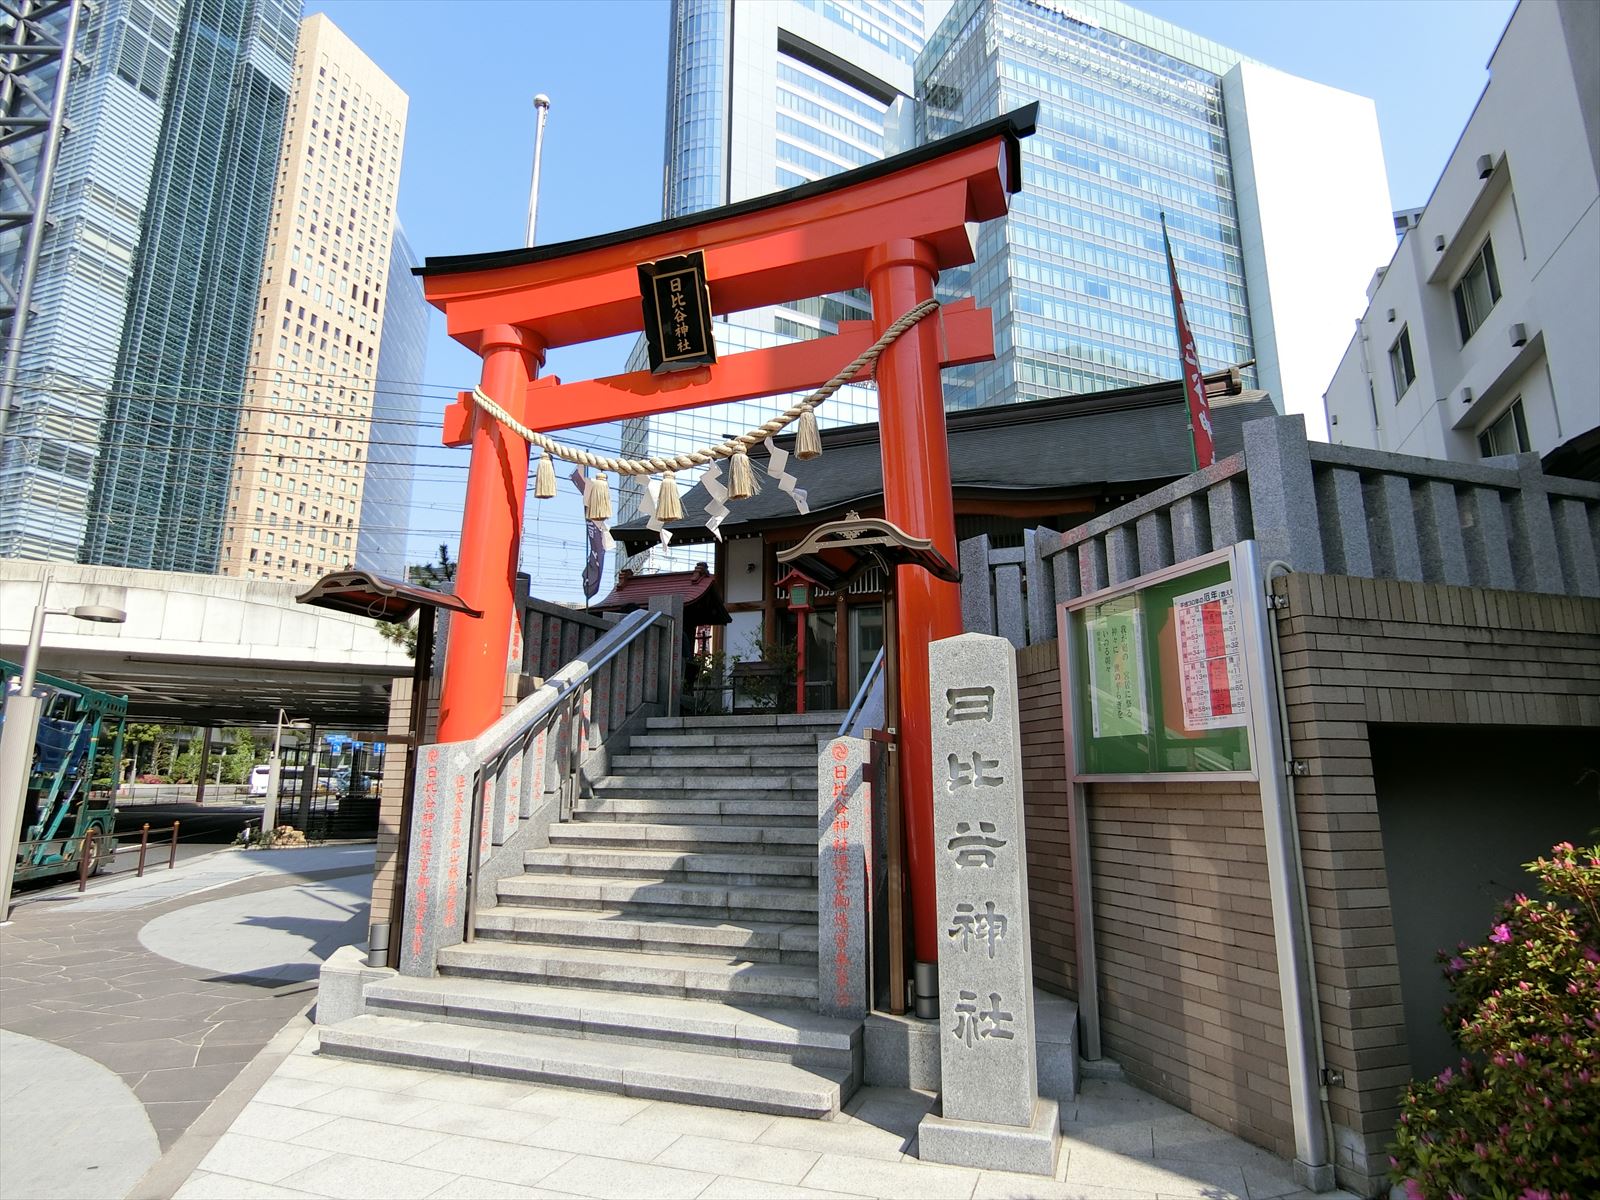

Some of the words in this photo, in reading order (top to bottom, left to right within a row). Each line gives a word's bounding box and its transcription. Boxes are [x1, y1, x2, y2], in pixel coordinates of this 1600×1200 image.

[670, 277, 691, 352] 日比谷神社
[946, 685, 1015, 1049] 日比谷神社
